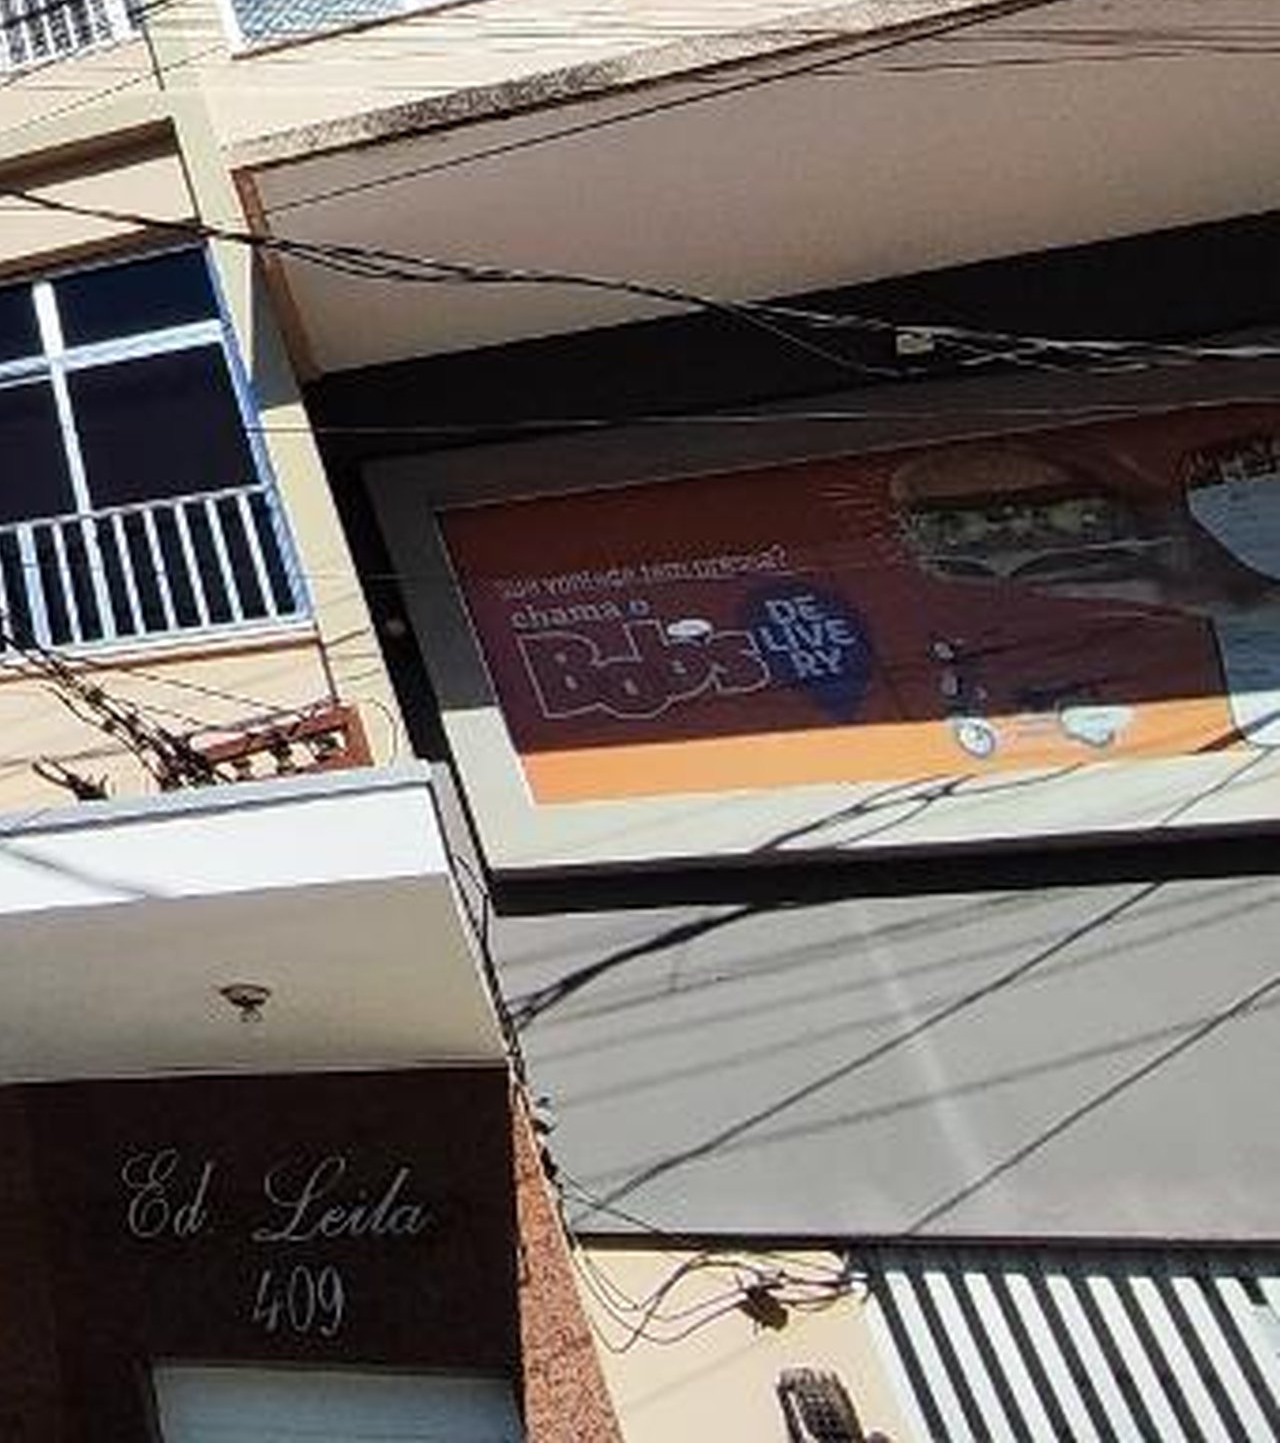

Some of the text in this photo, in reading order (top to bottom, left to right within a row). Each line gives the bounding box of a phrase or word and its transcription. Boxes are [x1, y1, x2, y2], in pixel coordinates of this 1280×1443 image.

[511, 599, 621, 630] chama
[765, 596, 824, 623] DE
[790, 650, 843, 678] RY
[252, 1157, 436, 1241] Leila
[252, 1266, 344, 1336] 409
